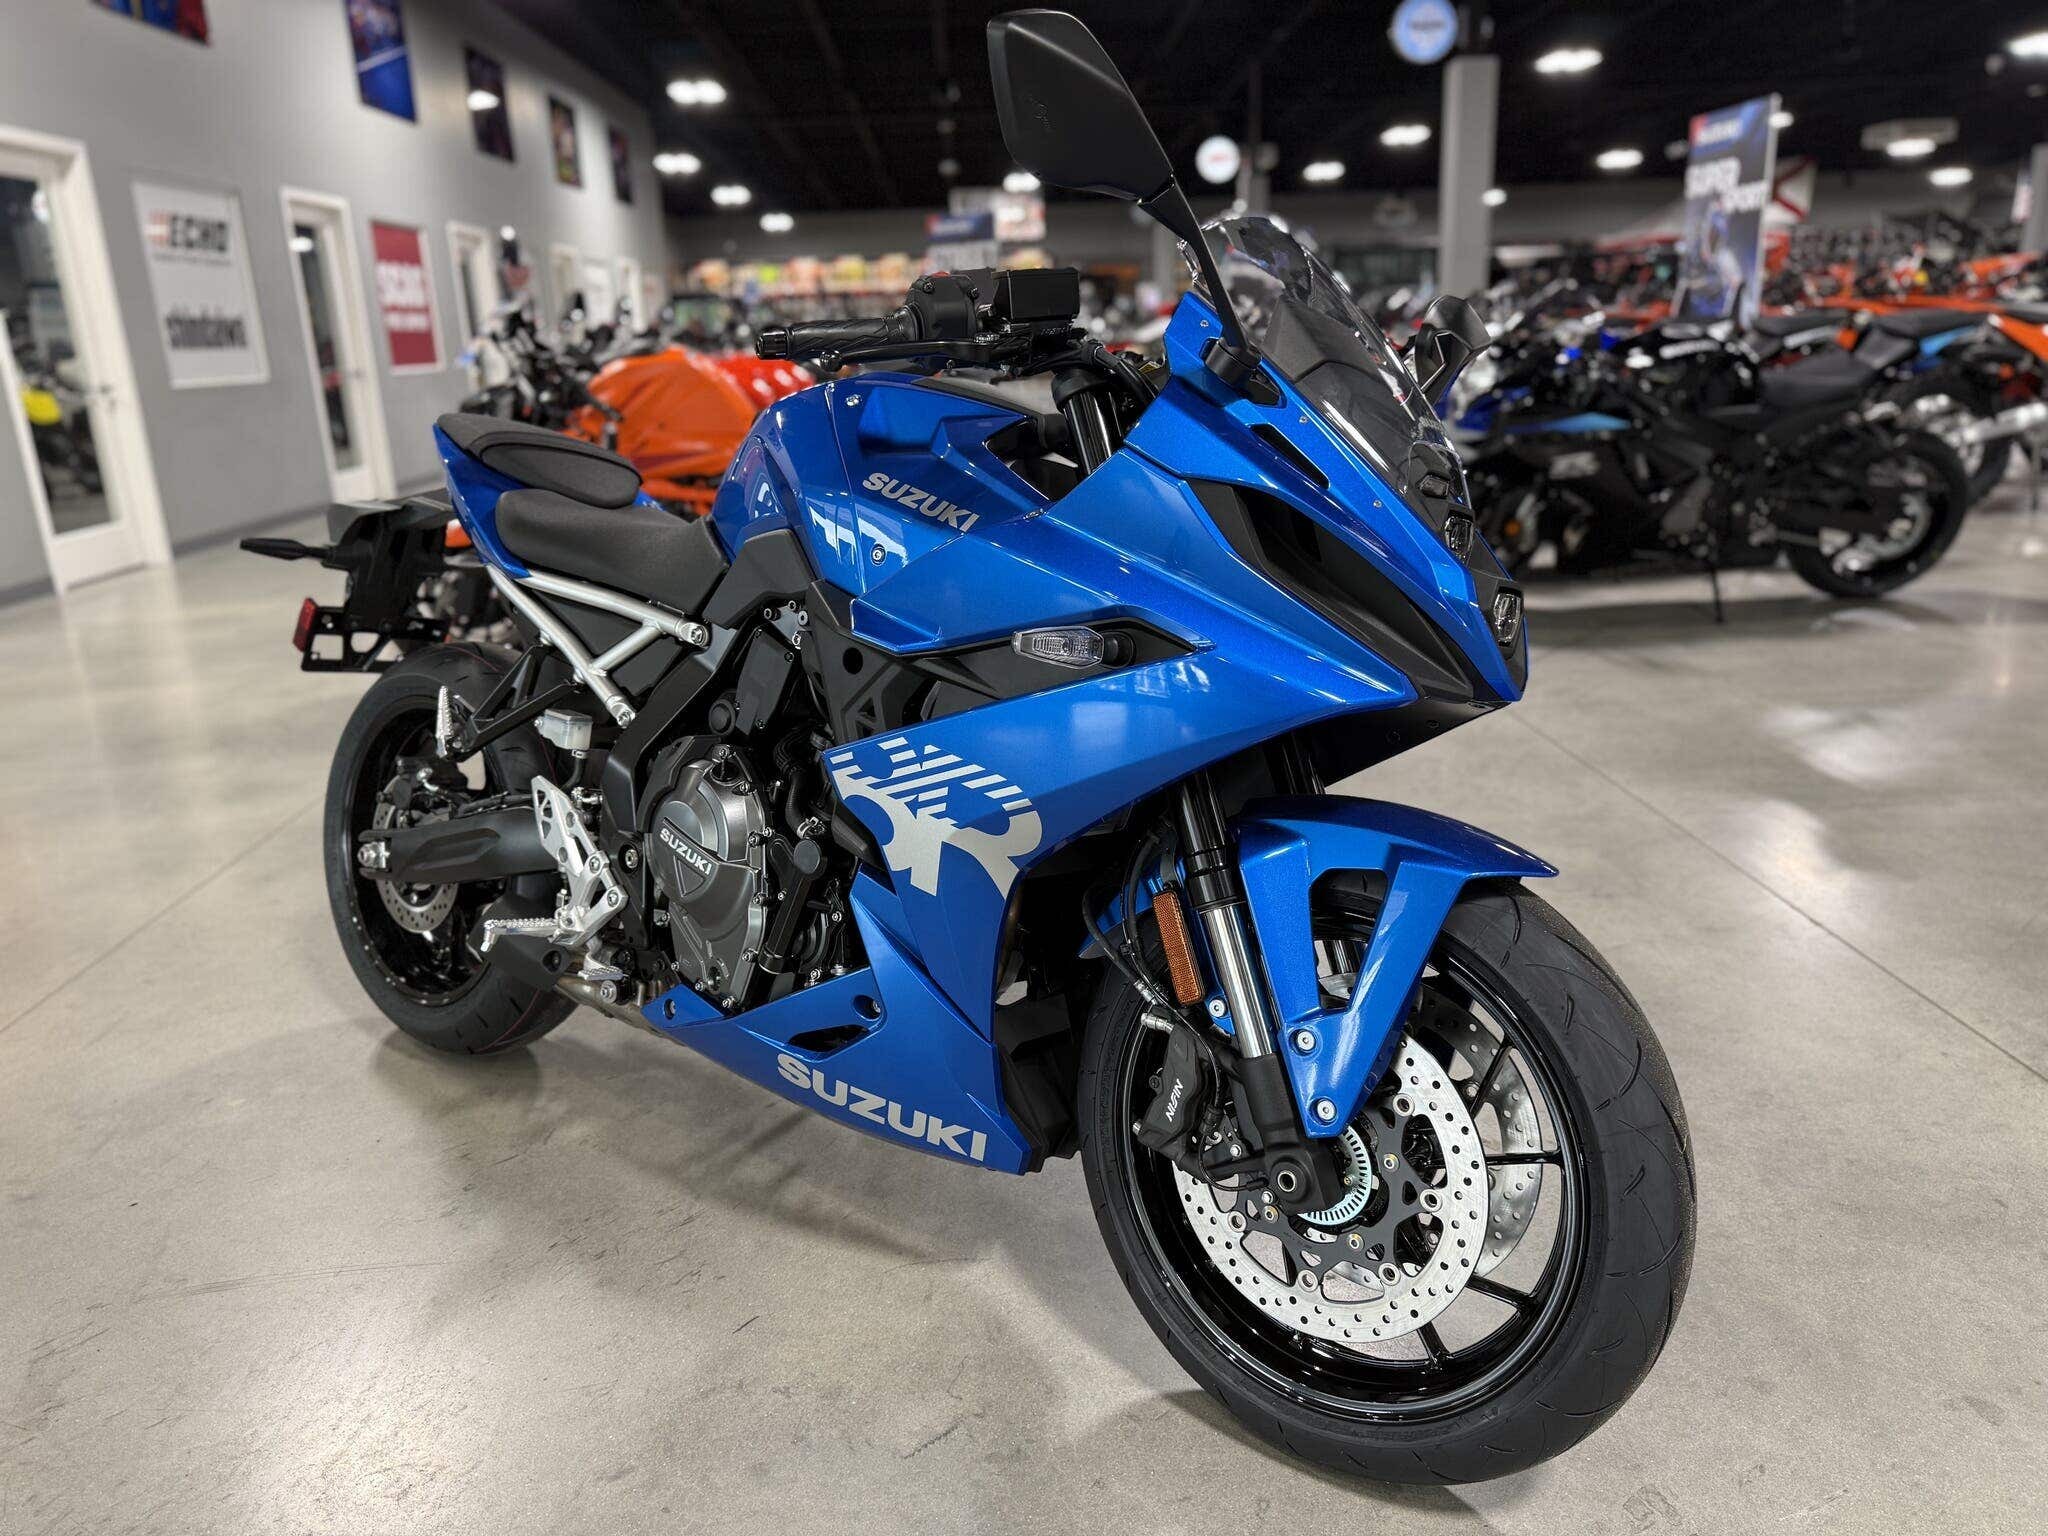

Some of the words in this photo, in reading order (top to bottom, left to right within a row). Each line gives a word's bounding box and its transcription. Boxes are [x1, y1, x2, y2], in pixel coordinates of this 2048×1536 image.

[862, 472, 980, 532] SUZUKI
[660, 828, 712, 875] SUZUKI
[777, 1053, 987, 1161] SUZUKI
